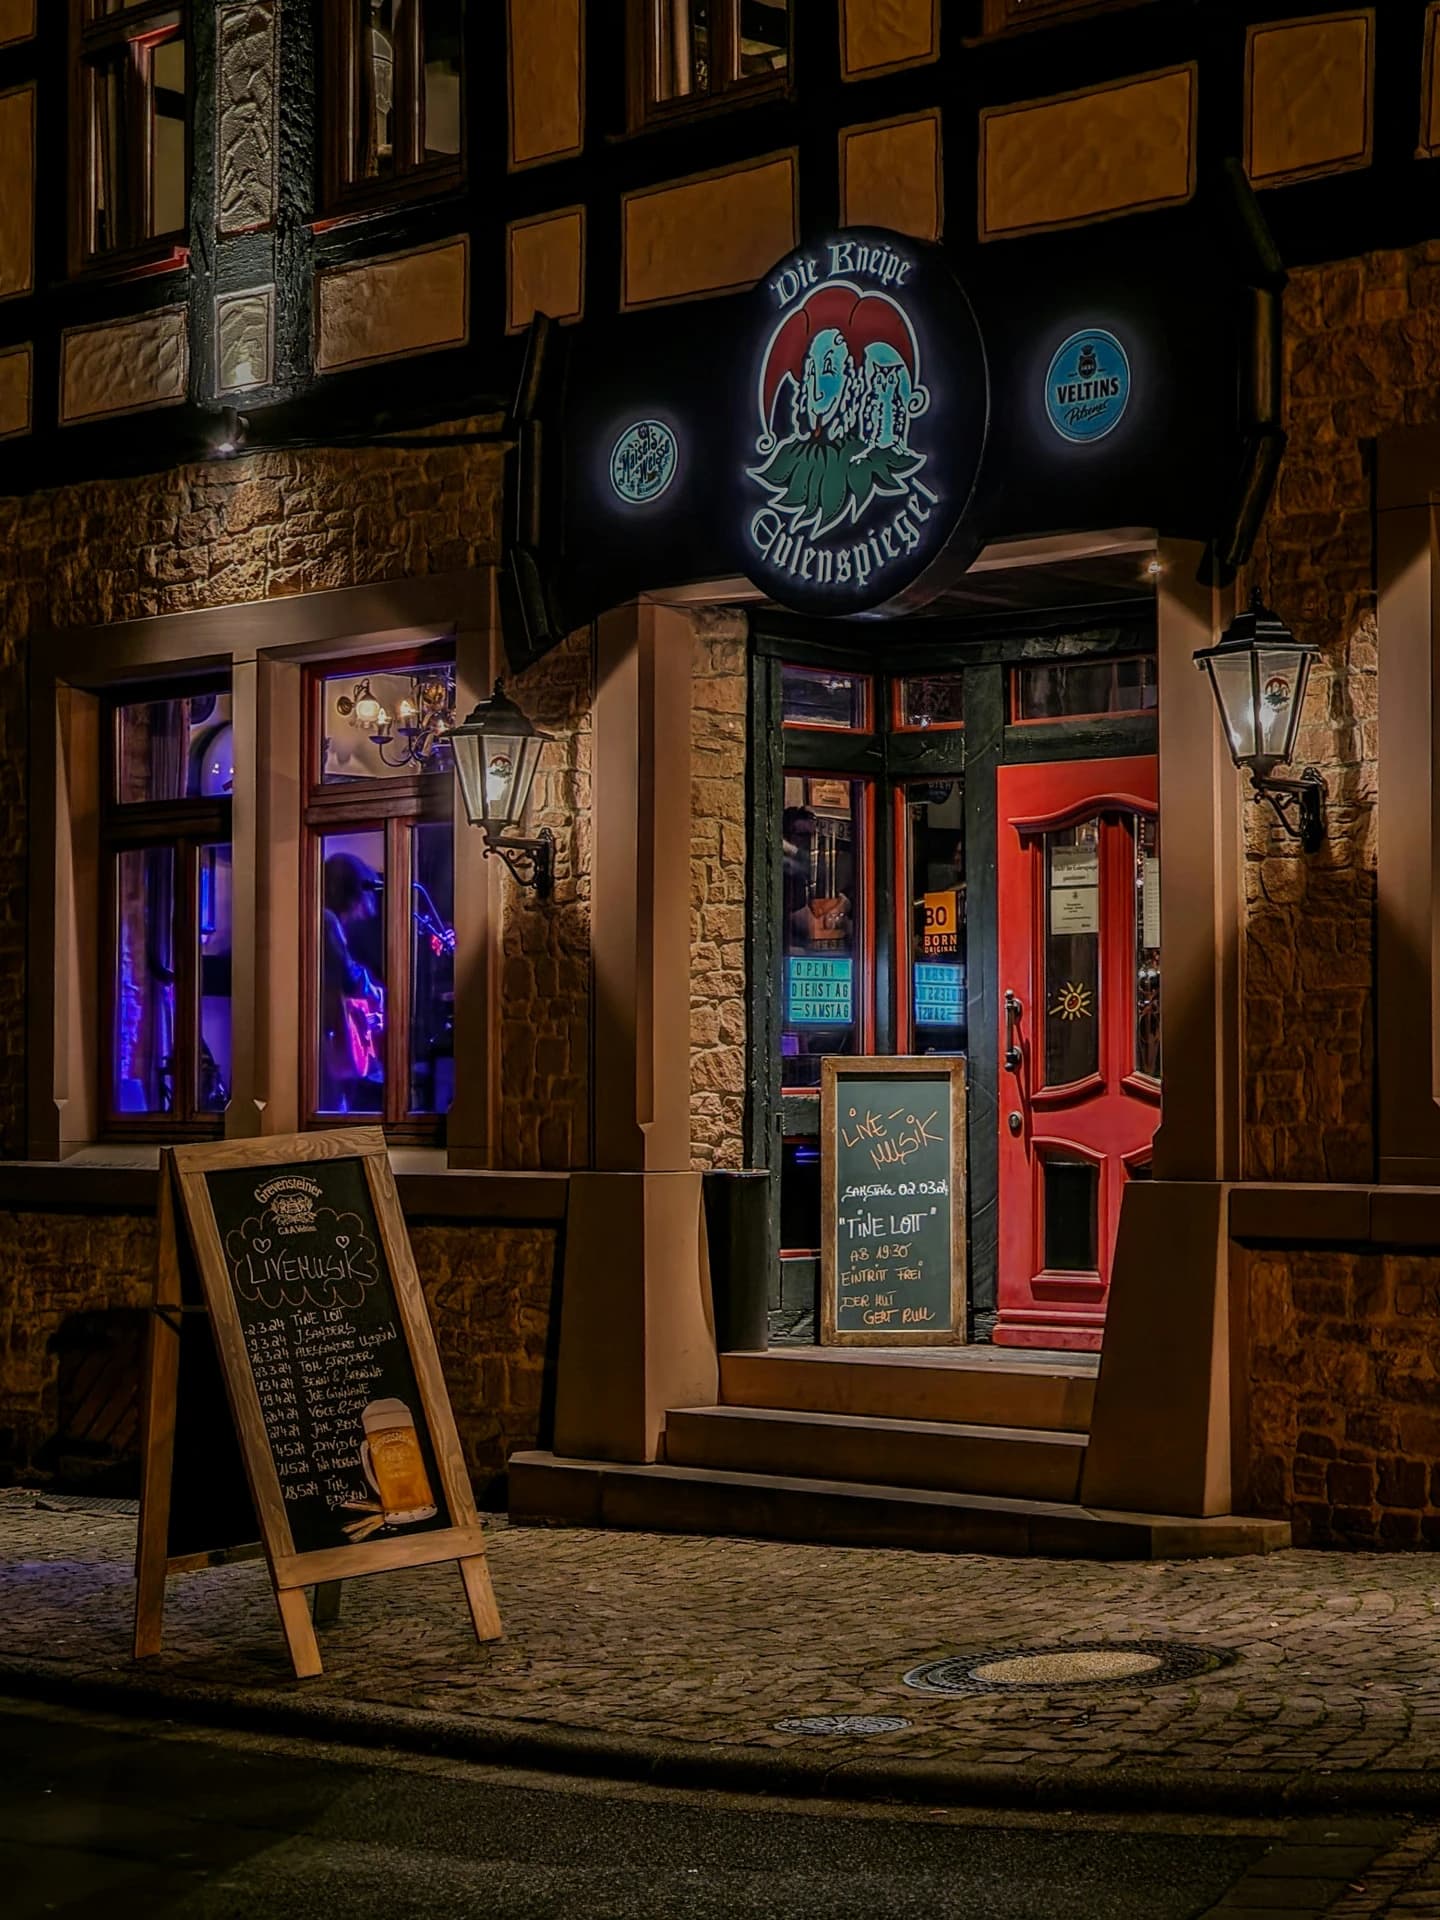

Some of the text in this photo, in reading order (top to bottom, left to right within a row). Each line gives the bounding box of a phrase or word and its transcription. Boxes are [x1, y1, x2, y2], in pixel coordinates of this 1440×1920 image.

[769, 241, 913, 310] Die Kneipe
[1057, 377, 1120, 405] VELTINS
[1064, 401, 1110, 426] Pilsener
[751, 477, 939, 586] Eulenspiegel
[924, 934, 957, 946] BORN
[870, 1111, 944, 1171] MUSIK
[850, 1247, 869, 1262] AB
[840, 1295, 870, 1312] DER
[305, 1322, 356, 1343] SANDERS
[305, 1389, 325, 1404] JOE
